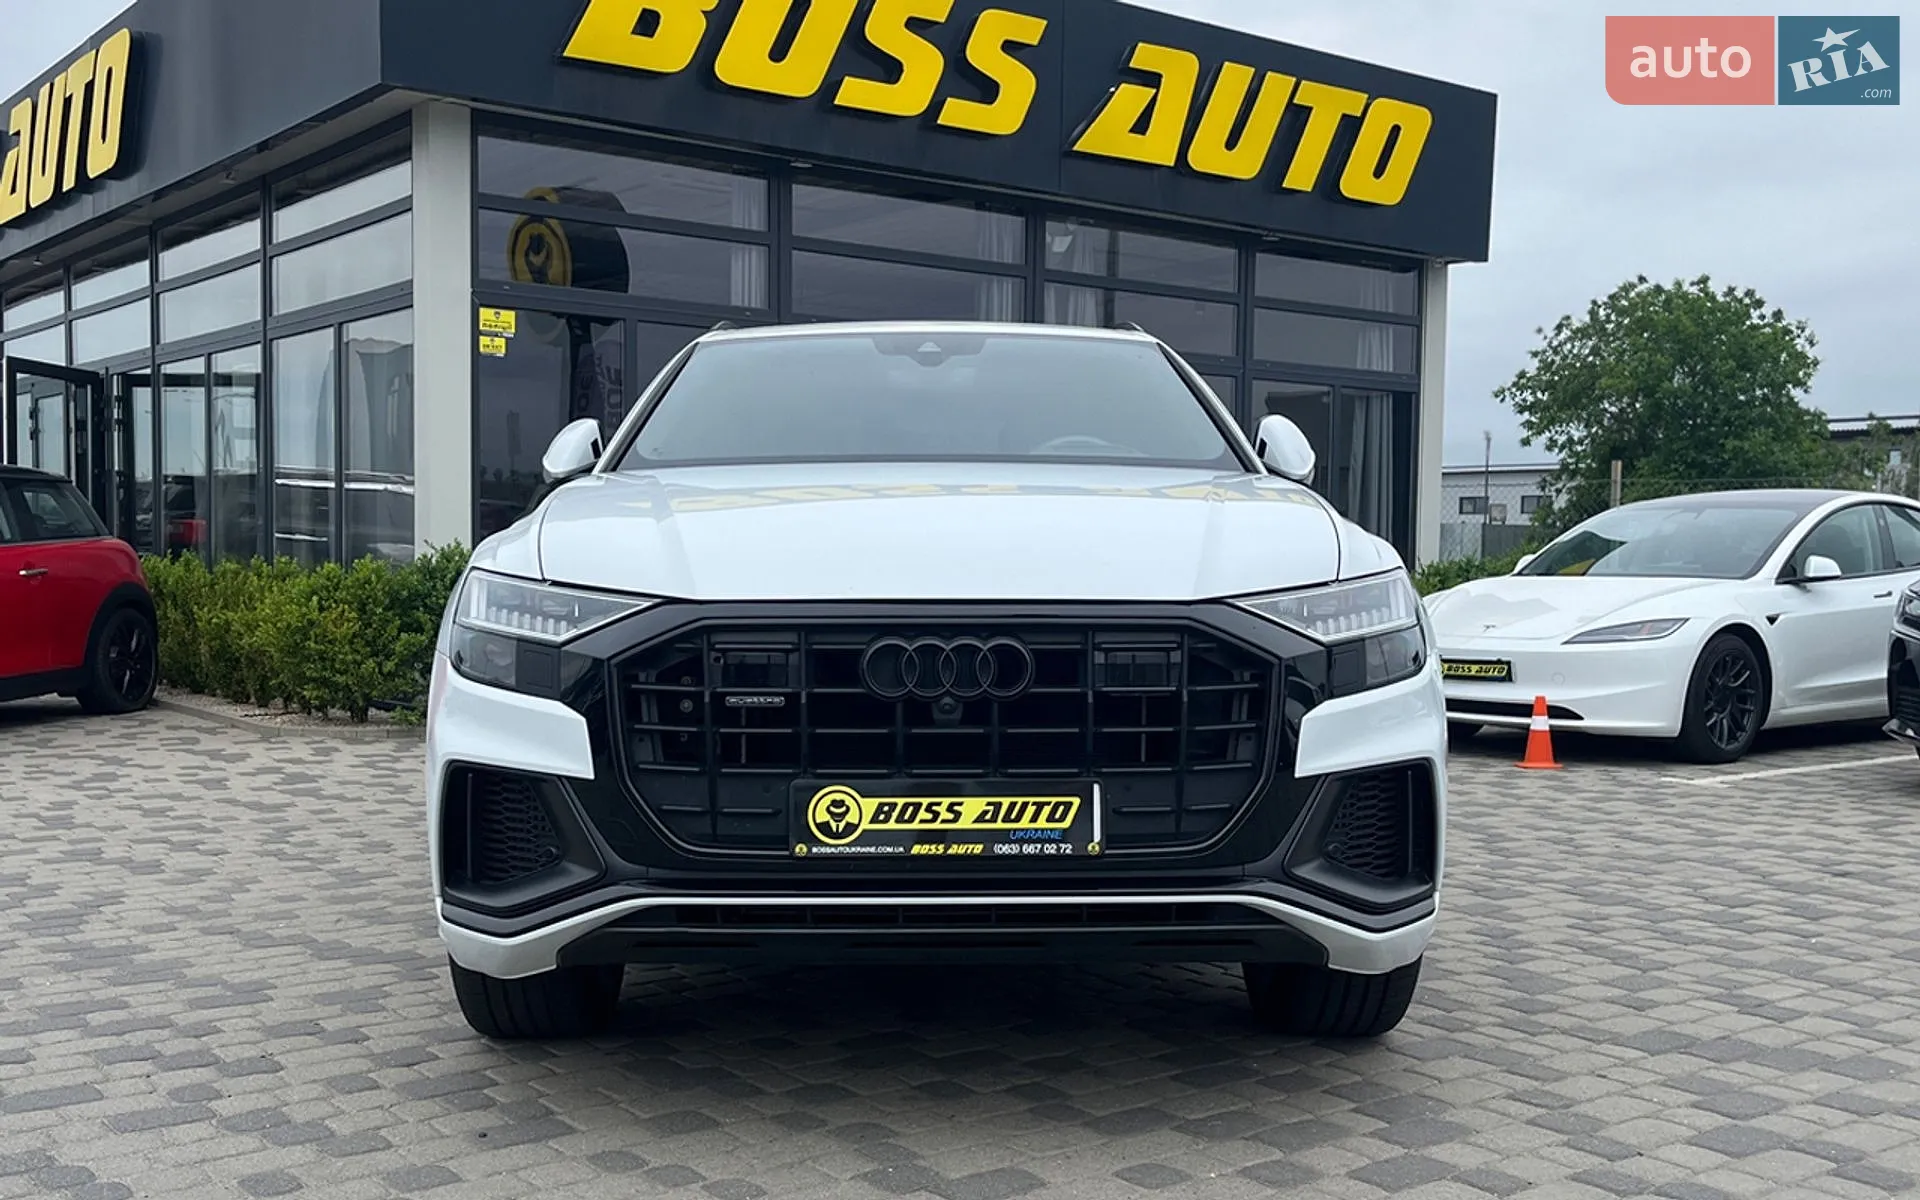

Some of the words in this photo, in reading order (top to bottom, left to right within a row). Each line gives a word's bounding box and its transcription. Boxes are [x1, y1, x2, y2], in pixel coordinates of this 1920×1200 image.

[0, 27, 131, 225] AUTO
[1072, 41, 1434, 206] AUTO
[1446, 664, 1473, 673] BOSS
[1474, 665, 1506, 675] AUTO
[868, 801, 964, 825] BOSS
[972, 801, 1074, 824] AUTO
[1009, 829, 1065, 840] UKRAINE
[811, 845, 905, 854] BOSSAUTOUKRAINE.COM.UA
[910, 843, 945, 855] BOSS
[946, 843, 984, 855] AUTO
[993, 843, 1020, 855] (063)
[1022, 843, 1041, 855] 667
[1043, 843, 1057, 855] 02
[1059, 843, 1073, 855] 72
